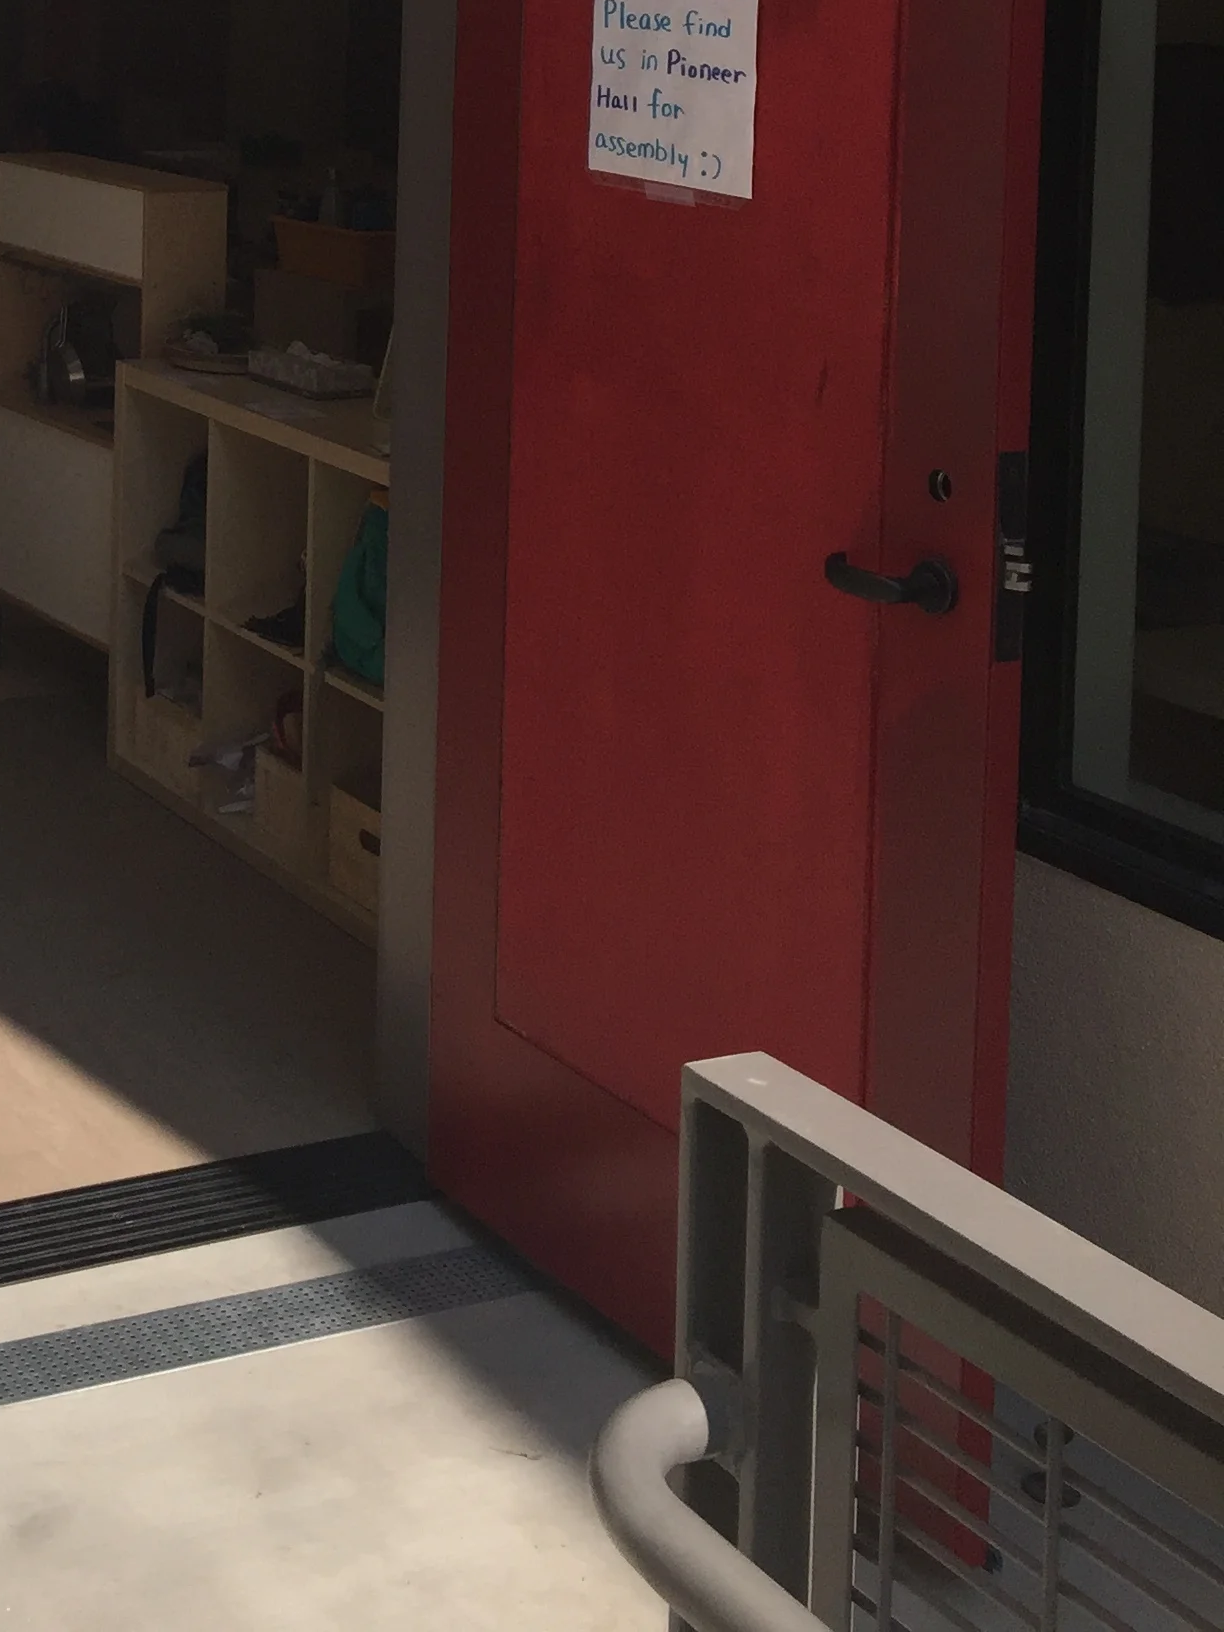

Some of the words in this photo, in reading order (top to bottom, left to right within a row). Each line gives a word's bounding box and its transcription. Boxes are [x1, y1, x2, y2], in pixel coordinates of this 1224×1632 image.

[682, 9, 732, 39] find
[600, 46, 626, 70] us
[641, 49, 658, 71] in
[666, 48, 747, 84] Pioneer
[597, 84, 638, 113] Hall
[647, 88, 685, 119] for
[595, 132, 689, 178] assembly
